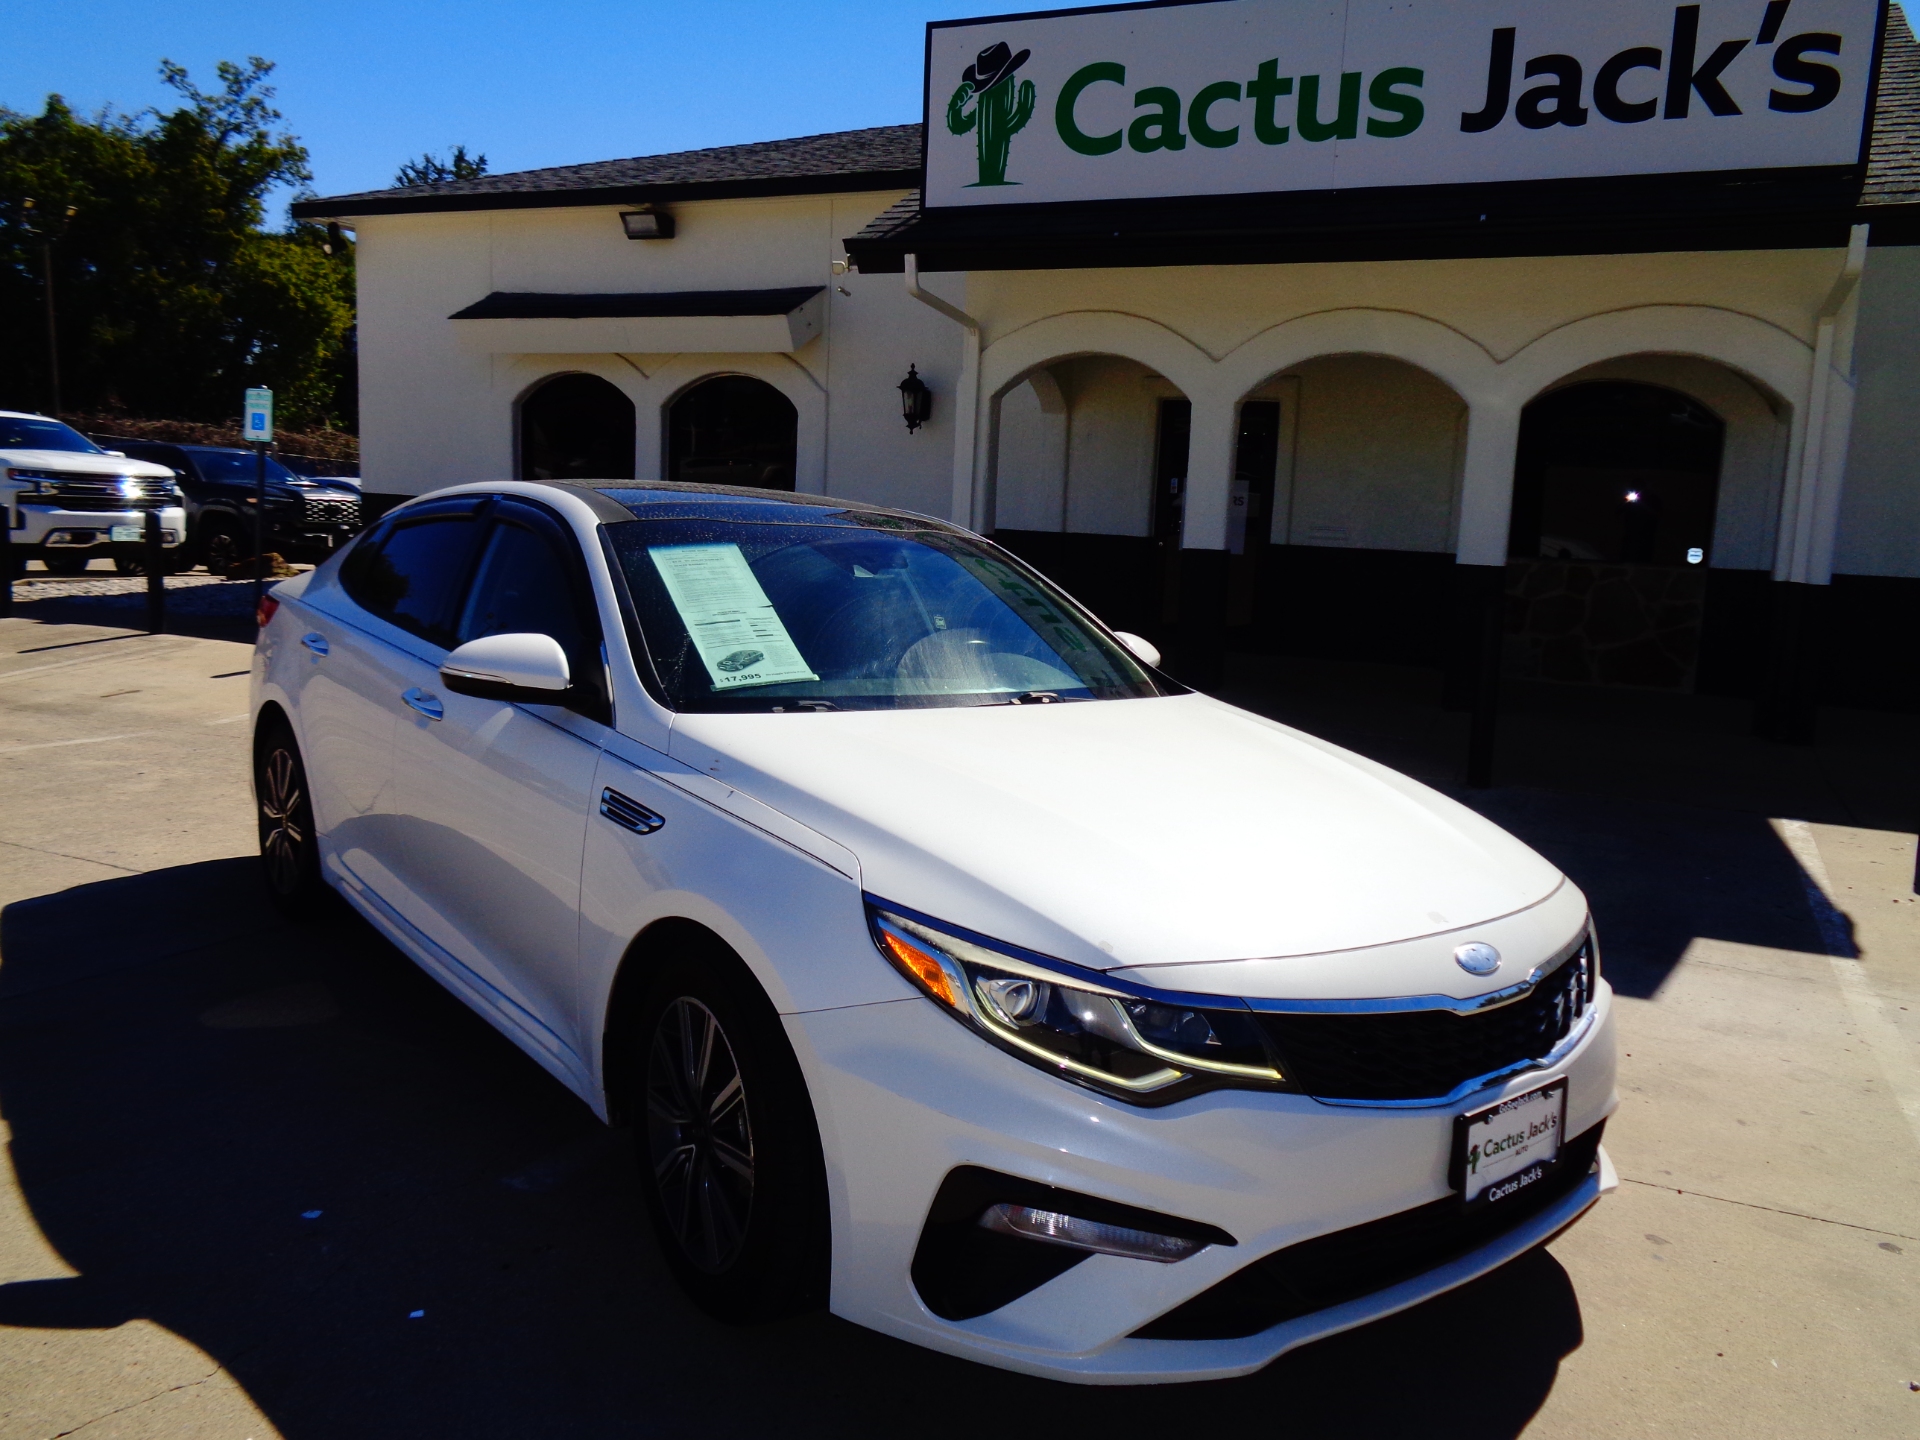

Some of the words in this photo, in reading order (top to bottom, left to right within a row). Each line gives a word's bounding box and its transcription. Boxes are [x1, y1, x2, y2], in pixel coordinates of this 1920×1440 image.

[1055, 57, 1424, 156] Cactus
[1460, 0, 1842, 133] Jack's
[1484, 1131, 1525, 1157] Cactus
[1527, 1112, 1557, 1140] Jack's
[1515, 1145, 1529, 1156] AUTO
[1489, 1181, 1518, 1202] Cactus
[1519, 1167, 1542, 1188] Jack's
